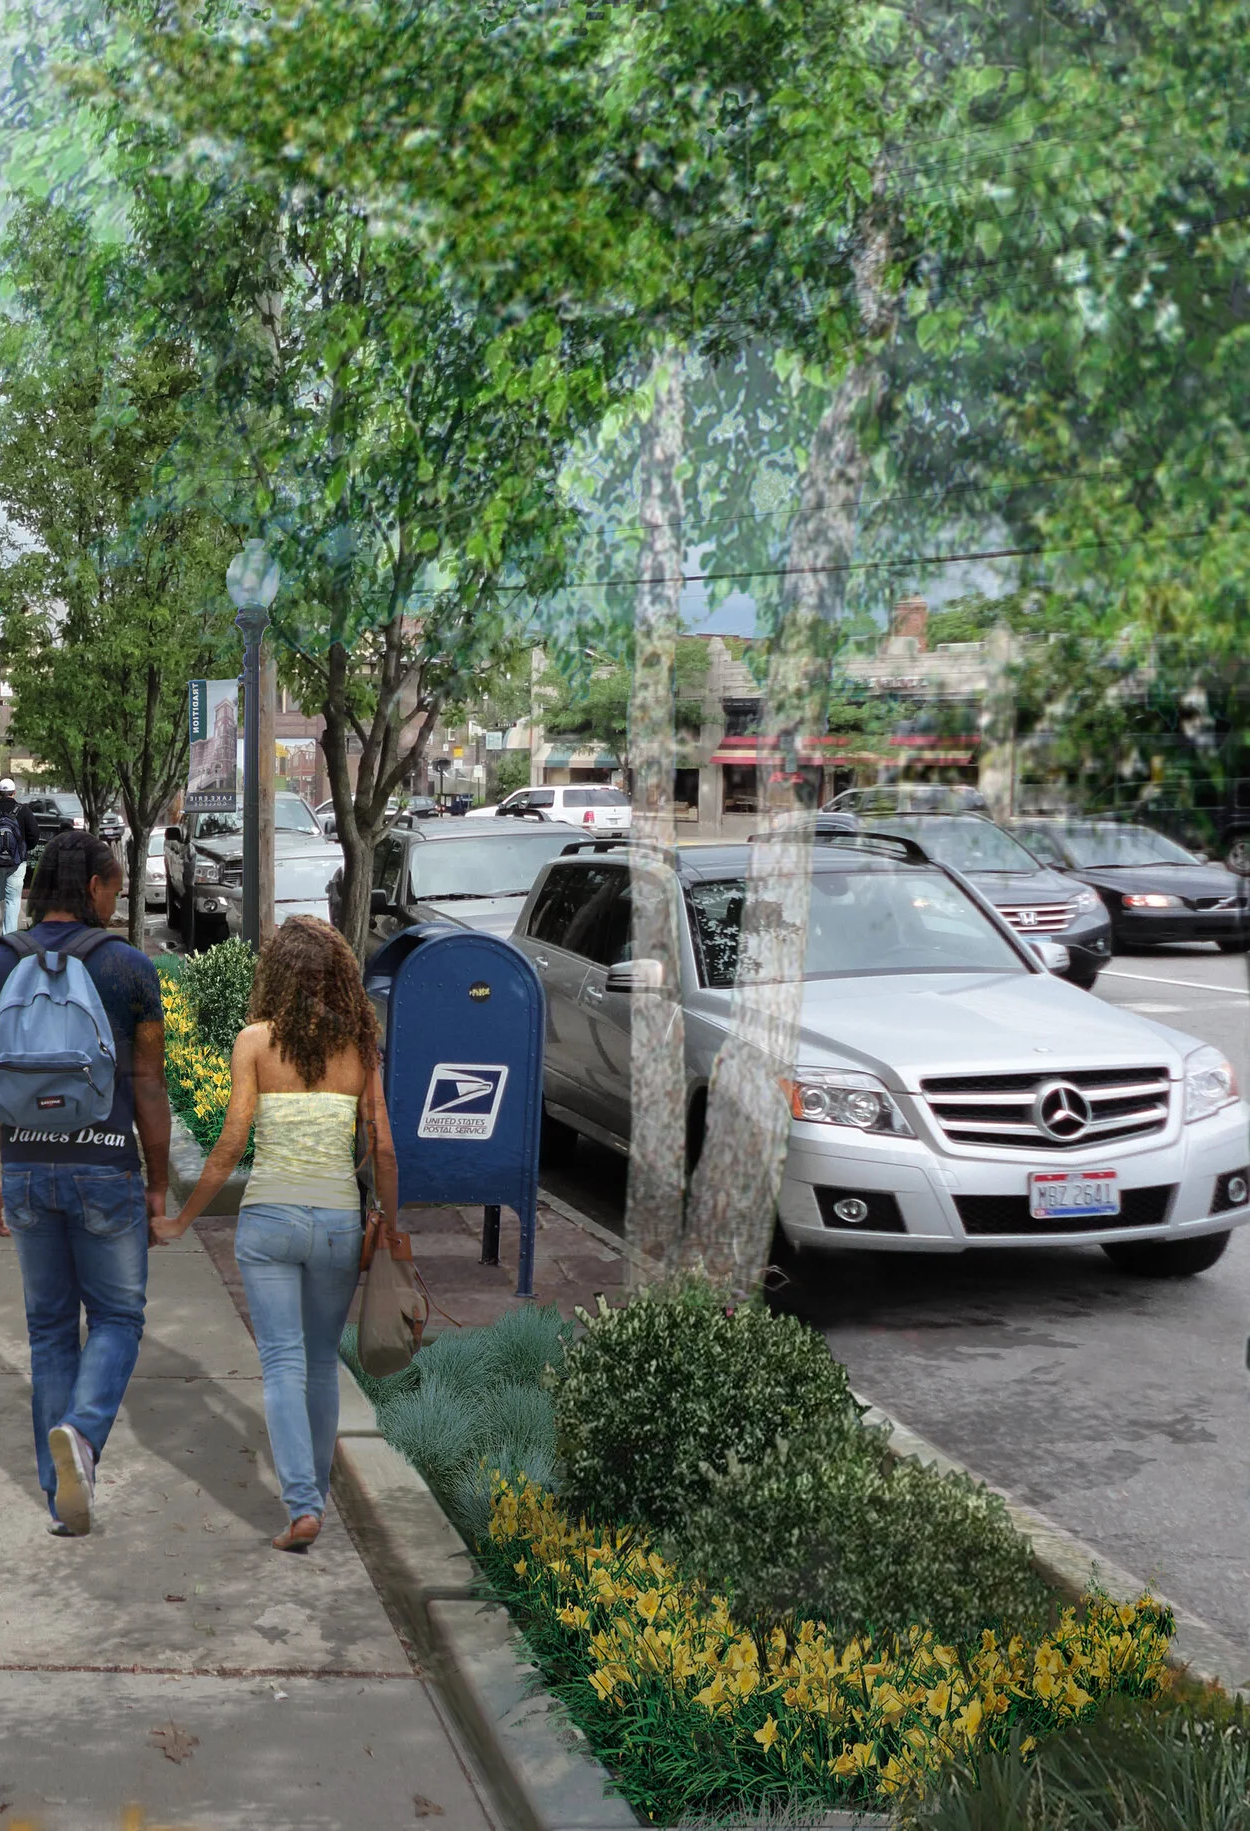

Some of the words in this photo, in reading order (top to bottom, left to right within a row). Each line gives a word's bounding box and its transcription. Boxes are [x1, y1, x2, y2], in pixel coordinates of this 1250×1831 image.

[425, 1117, 456, 1125] UNITED
[457, 1118, 485, 1126] STATES
[9, 1126, 70, 1143] James
[75, 1127, 126, 1147] Dean
[423, 1126, 452, 1134] POSTAL
[455, 1127, 487, 1135] SERVICE
[1075, 1183, 1112, 1206] 2641
